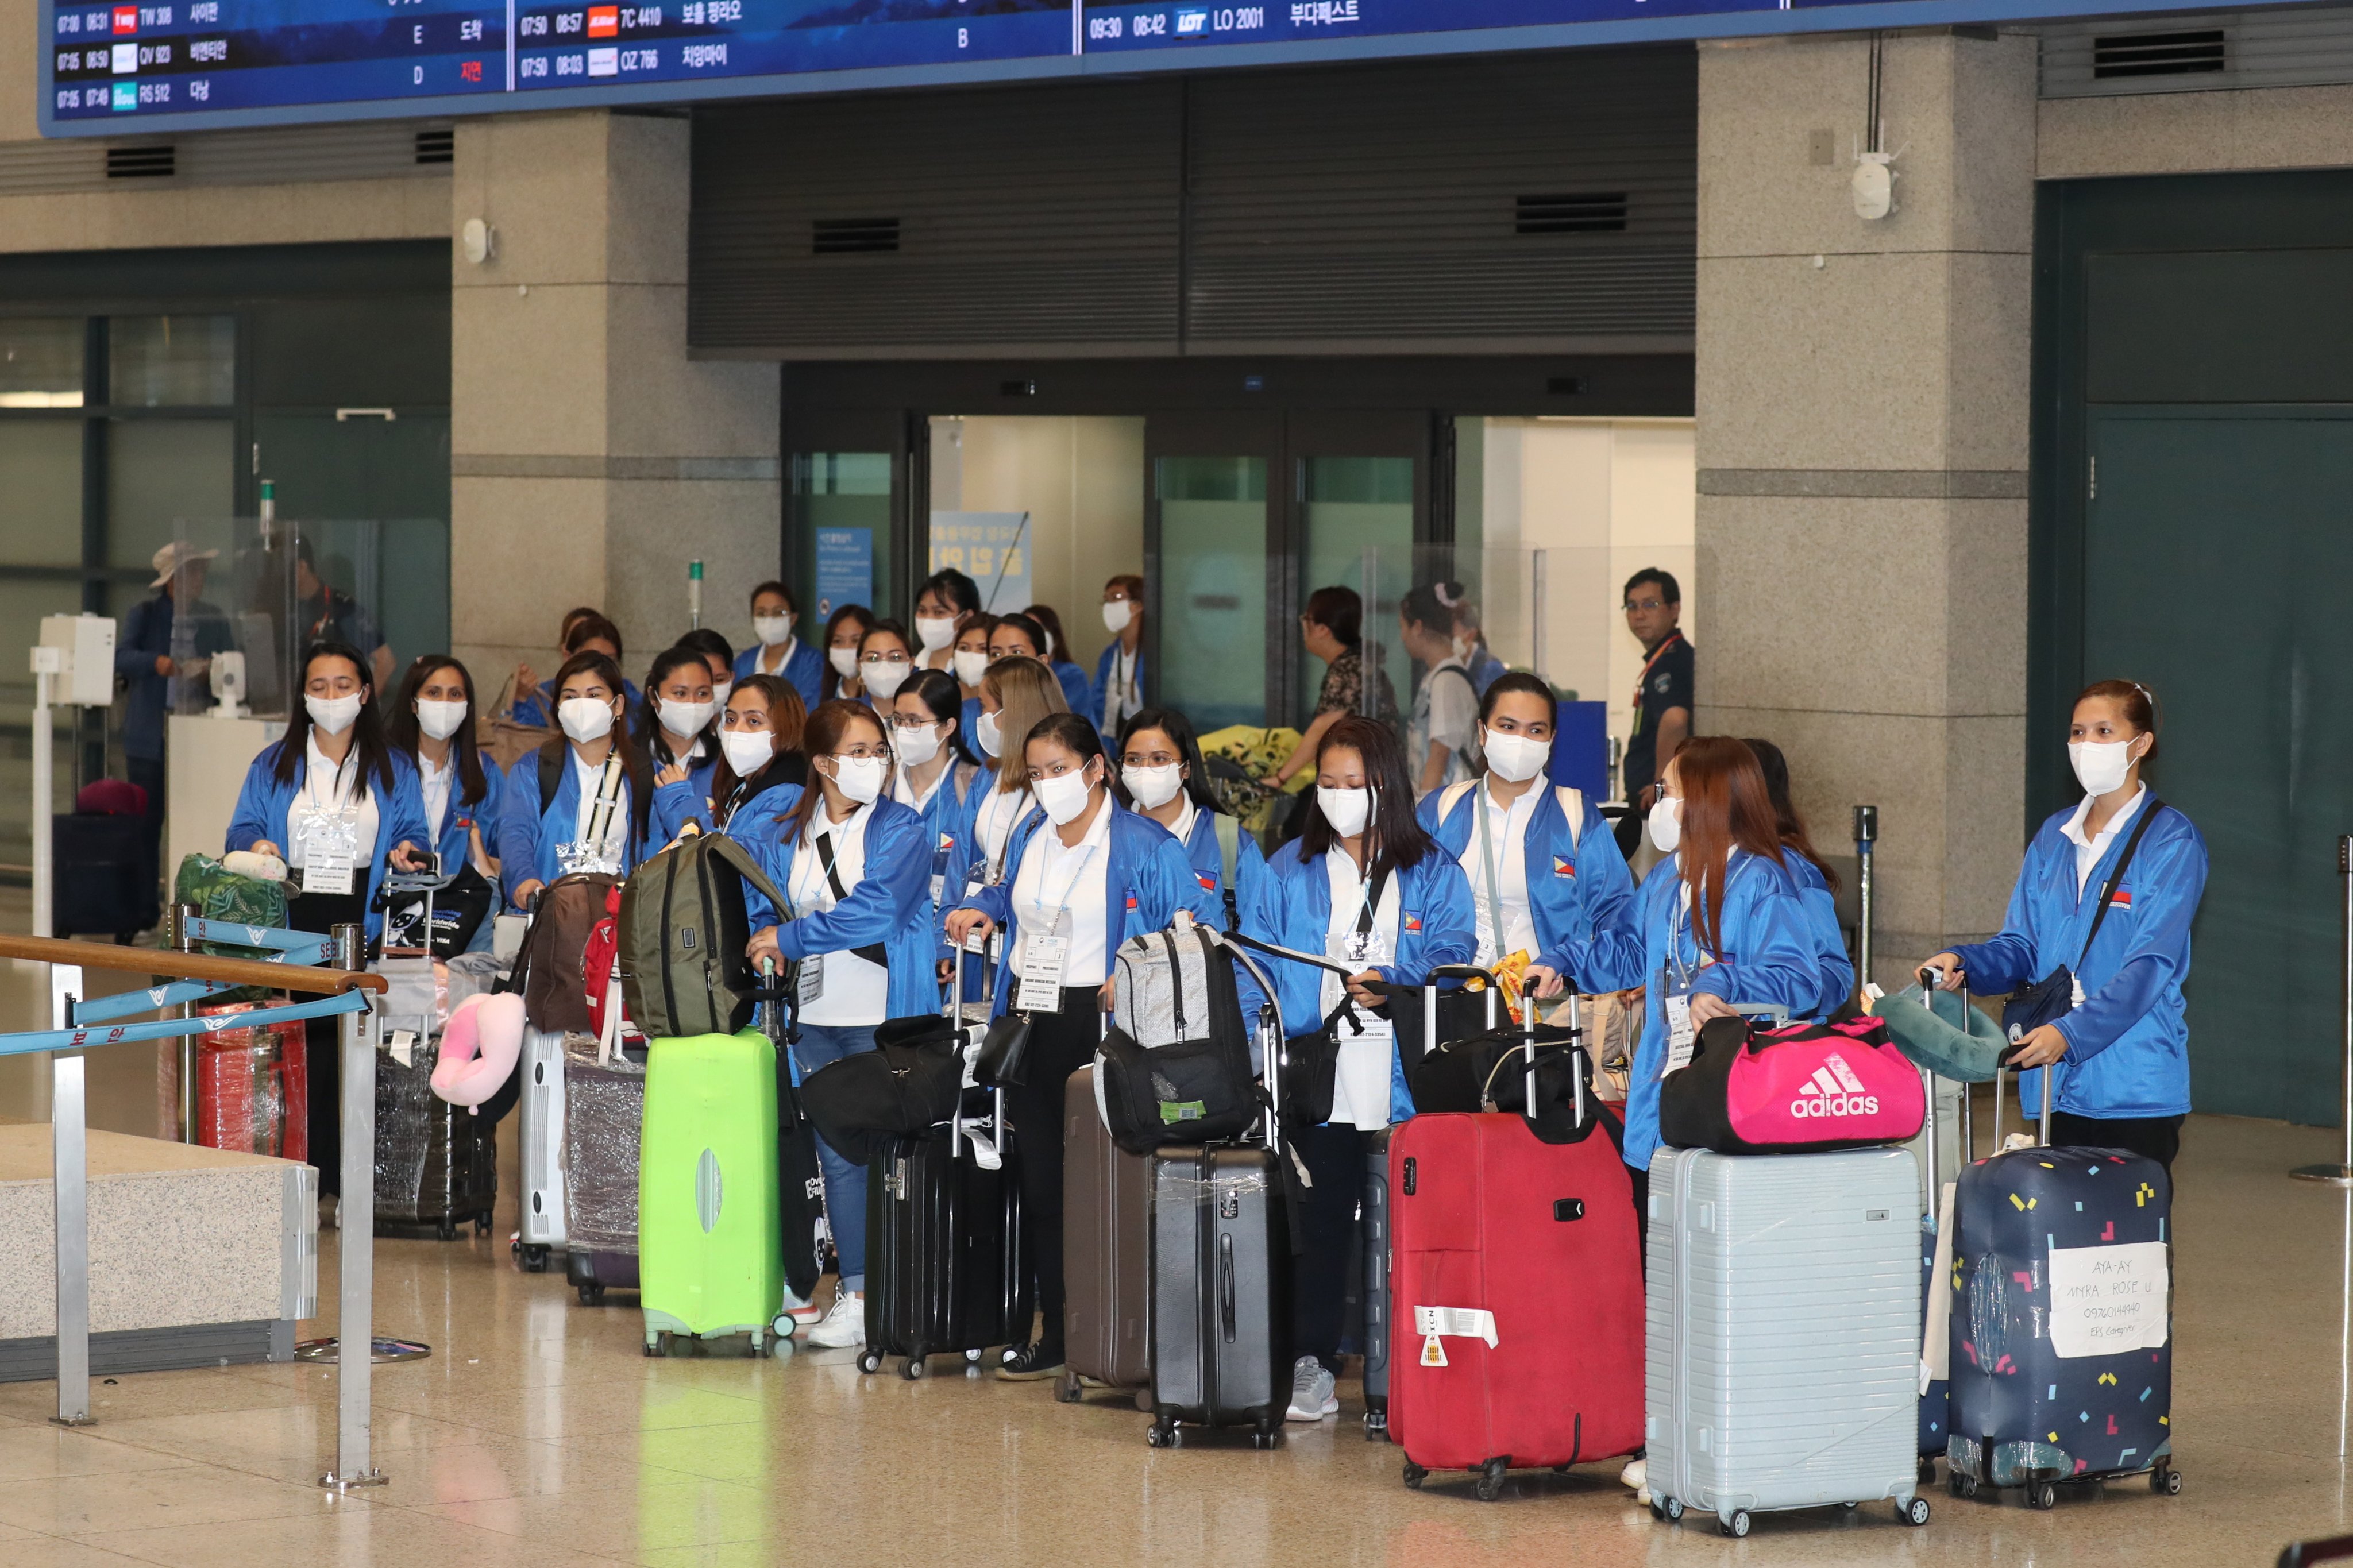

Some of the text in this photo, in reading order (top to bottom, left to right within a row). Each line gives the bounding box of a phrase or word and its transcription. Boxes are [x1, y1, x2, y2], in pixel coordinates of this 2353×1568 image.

[140, 9, 156, 26] TW
[520, 16, 547, 36] 07:50
[621, 9, 636, 28] 7C
[637, 7, 662, 26] 4410
[1090, 0, 1360, 39] 09:30 08:42 LOT LO 2001 부다페스트
[414, 25, 423, 44] E
[460, 19, 483, 41] 도착
[958, 28, 969, 48] B
[520, 57, 547, 78] 07:50
[621, 52, 638, 71] OZ
[682, 43, 727, 68] 치앙마이
[414, 66, 423, 84] D
[461, 61, 481, 82] 지연
[190, 80, 210, 101] 다낭
[437, 937, 450, 945] VISA
[1791, 1092, 1878, 1118] adidas
[2092, 1260, 2132, 1274] AYA-AY
[2112, 1281, 2139, 1295] ROSE
[2146, 1281, 2151, 1293] U
[2091, 1325, 2136, 1337] EPS Caregiver
